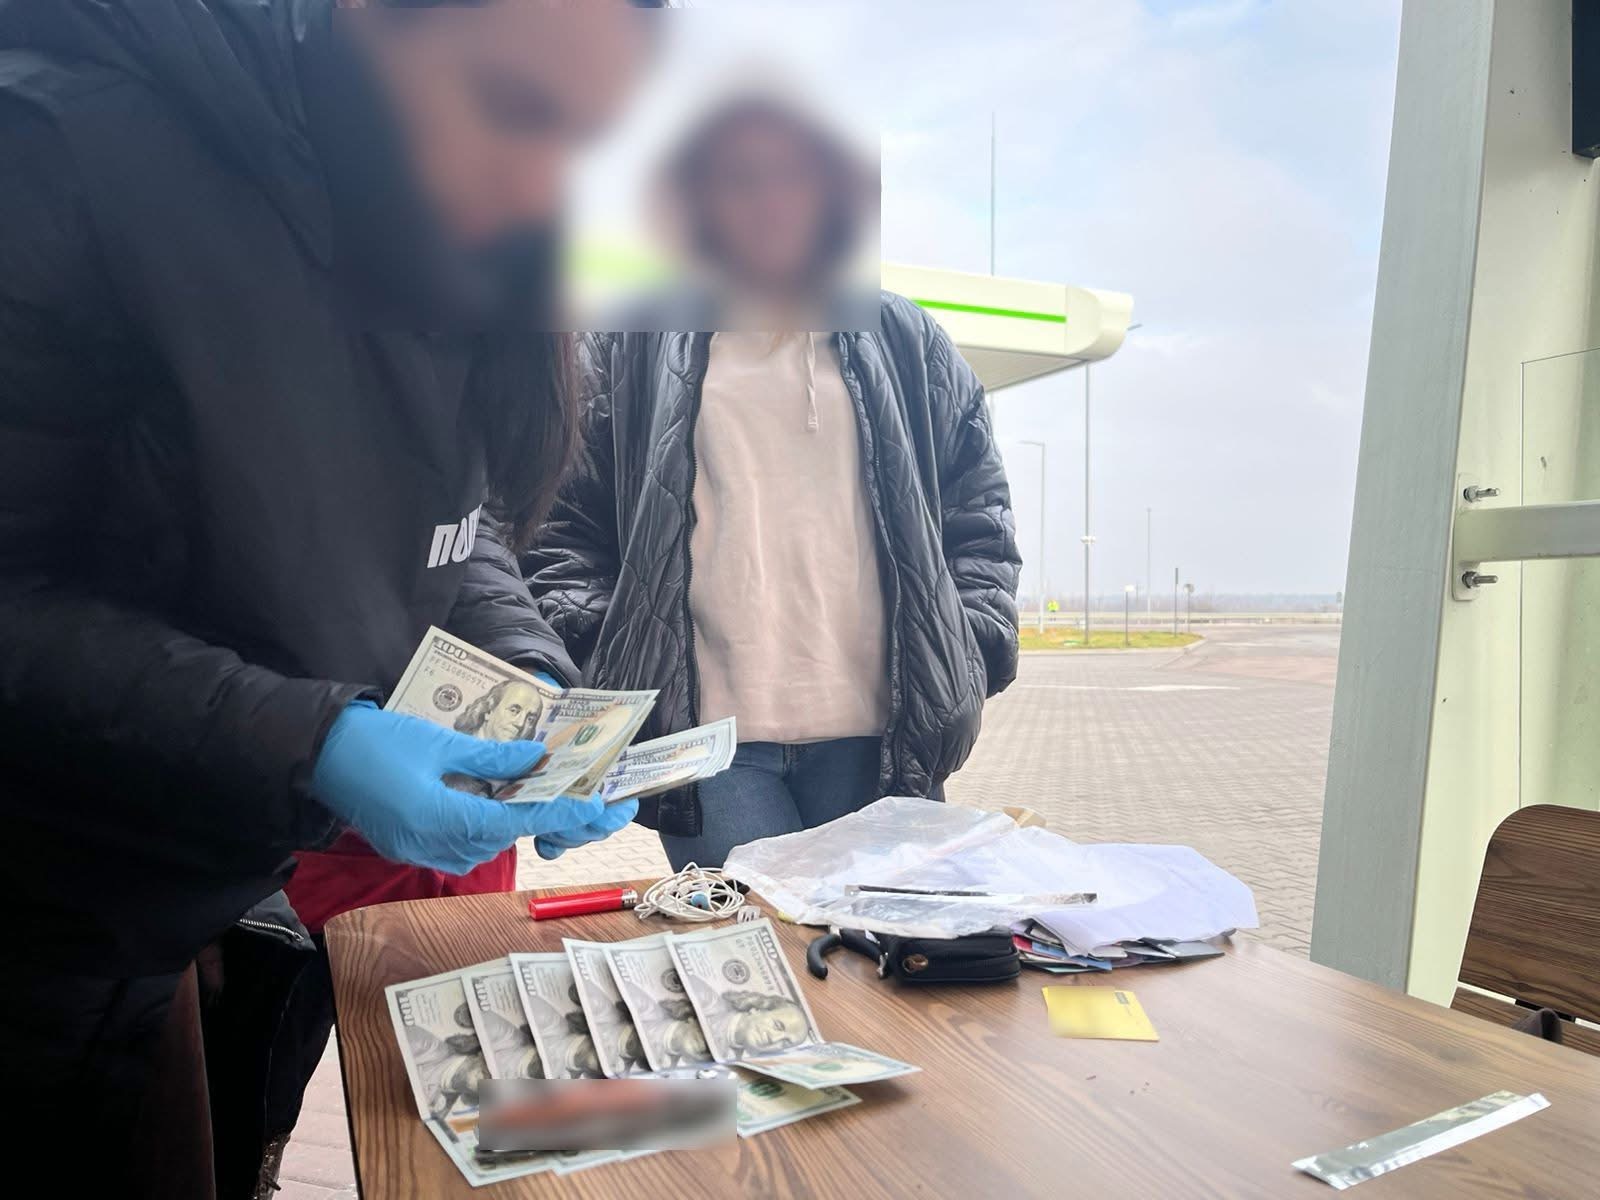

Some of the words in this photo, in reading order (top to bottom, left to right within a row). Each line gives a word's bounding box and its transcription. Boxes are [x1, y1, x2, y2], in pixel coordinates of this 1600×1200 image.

[434, 639, 469, 661] 100
[760, 930, 778, 960] 100
[522, 966, 538, 997] 100
[398, 995, 415, 1027] 100
[474, 982, 491, 1012] 100
